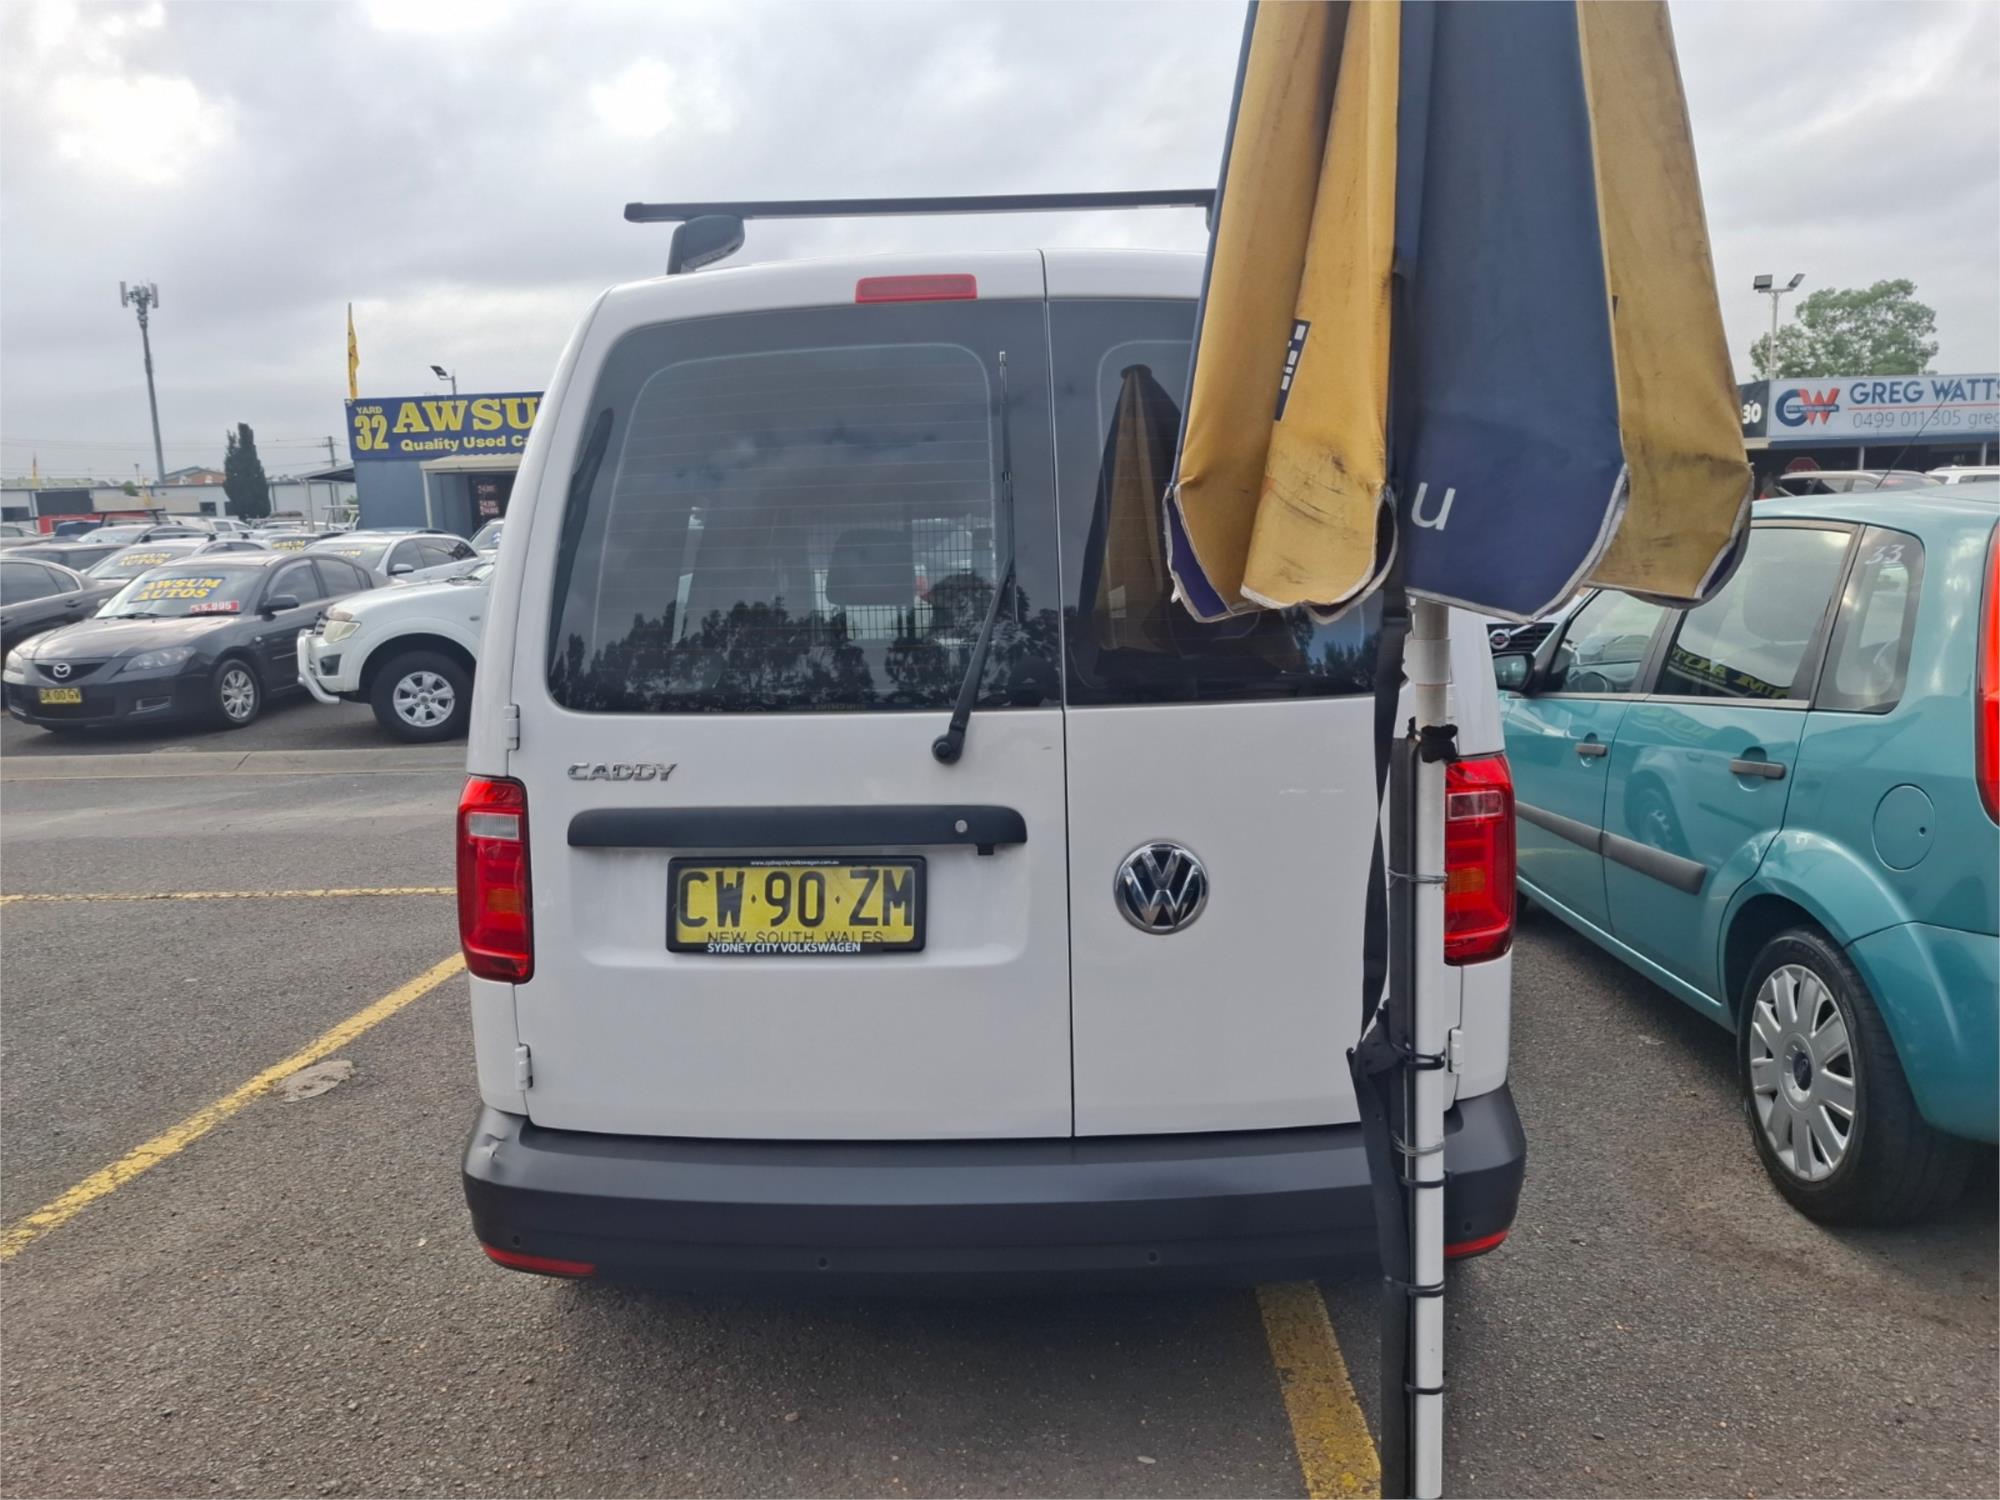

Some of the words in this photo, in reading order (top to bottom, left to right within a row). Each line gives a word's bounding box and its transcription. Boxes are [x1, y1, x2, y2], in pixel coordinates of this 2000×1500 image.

[1849, 381, 1924, 404] GREG
[356, 406, 383, 415] YARD
[393, 396, 543, 433] AWSU
[1742, 403, 1762, 424] 30
[1852, 411, 1895, 429] 0499
[1900, 410, 1926, 427] 011
[1931, 408, 1961, 426] 305
[354, 414, 389, 451] 32
[400, 437, 459, 452] Quality
[463, 435, 506, 449] Used
[145, 578, 224, 590] AWSUM
[136, 588, 210, 600] AUTOS
[567, 762, 678, 781] CADDY
[707, 931, 746, 943] NEW
[756, 931, 815, 943] SOUTH
[825, 931, 884, 943] WALES
[707, 943, 752, 953] SYDNEY
[754, 943, 780, 953] CITY
[781, 943, 861, 953] VOLKSWAGEN
